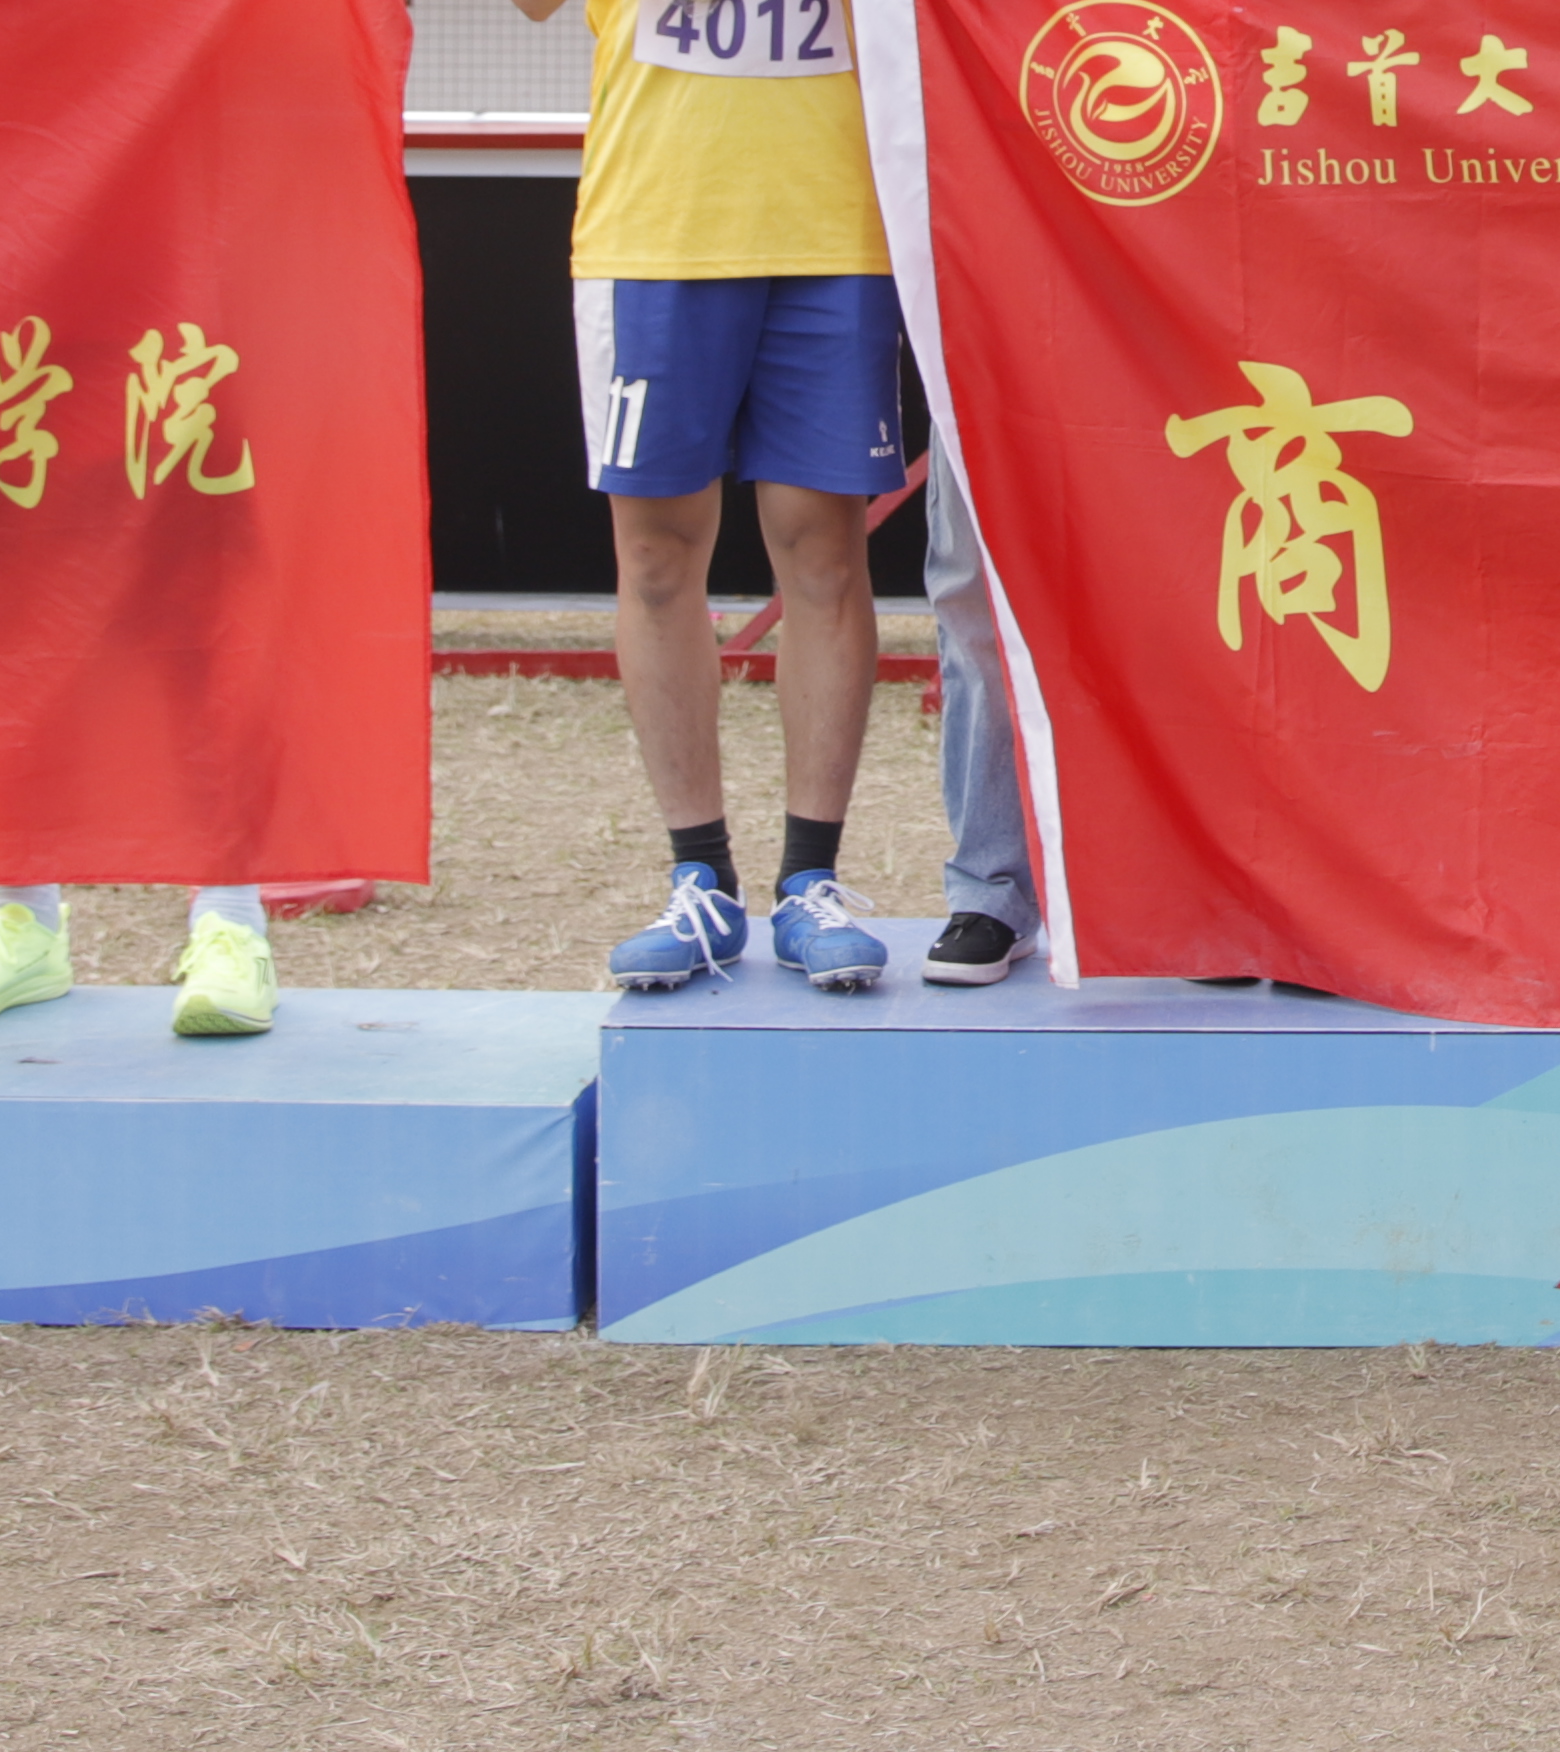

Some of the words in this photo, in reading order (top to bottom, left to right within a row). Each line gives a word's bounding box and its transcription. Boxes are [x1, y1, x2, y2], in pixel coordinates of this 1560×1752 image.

[1034, 108, 1093, 180] JISHOU
[1100, 116, 1208, 193] UNIVERSITY
[1103, 161, 1145, 174] 1958
[1257, 148, 1397, 186] Jishou
[601, 375, 648, 469] 11
